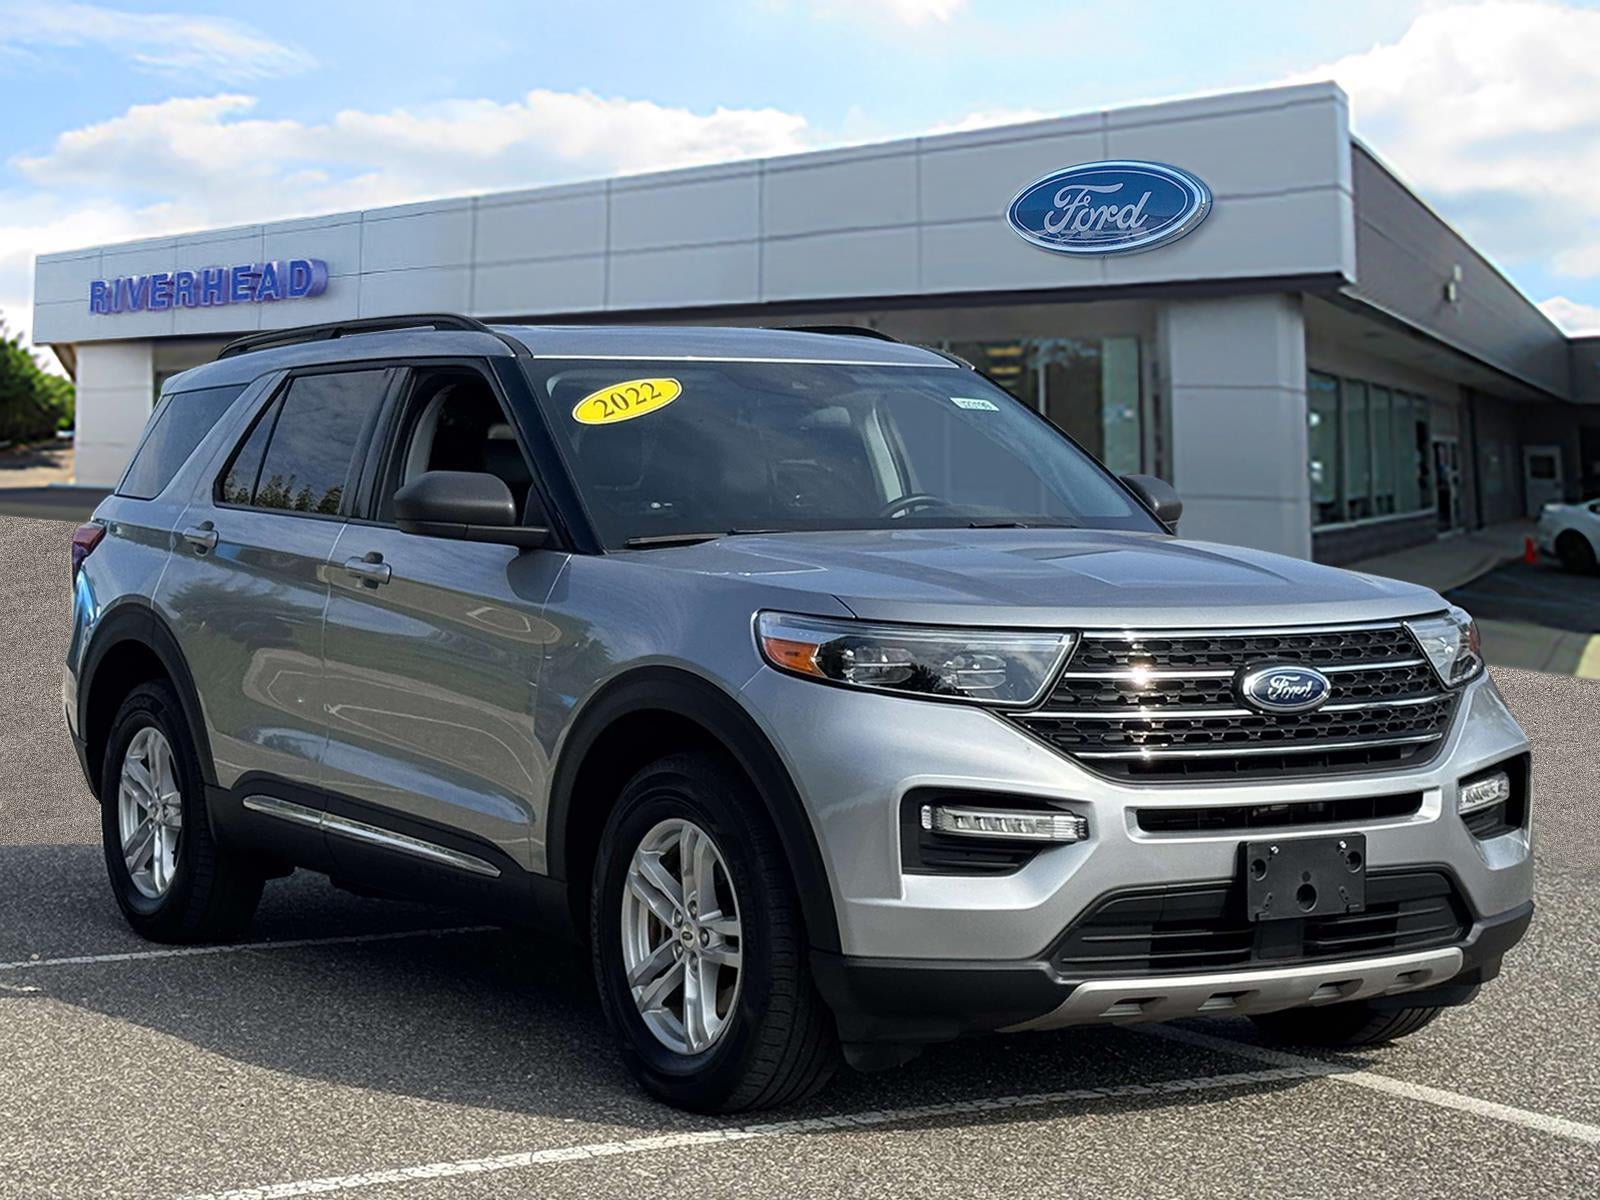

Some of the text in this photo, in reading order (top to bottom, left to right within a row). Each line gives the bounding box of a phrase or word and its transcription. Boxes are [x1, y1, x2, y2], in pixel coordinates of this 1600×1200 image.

[1043, 182, 1153, 234] Ford
[89, 260, 318, 314] RIVERHEAD
[593, 382, 662, 418] 2022
[1267, 675, 1314, 700] Ford
